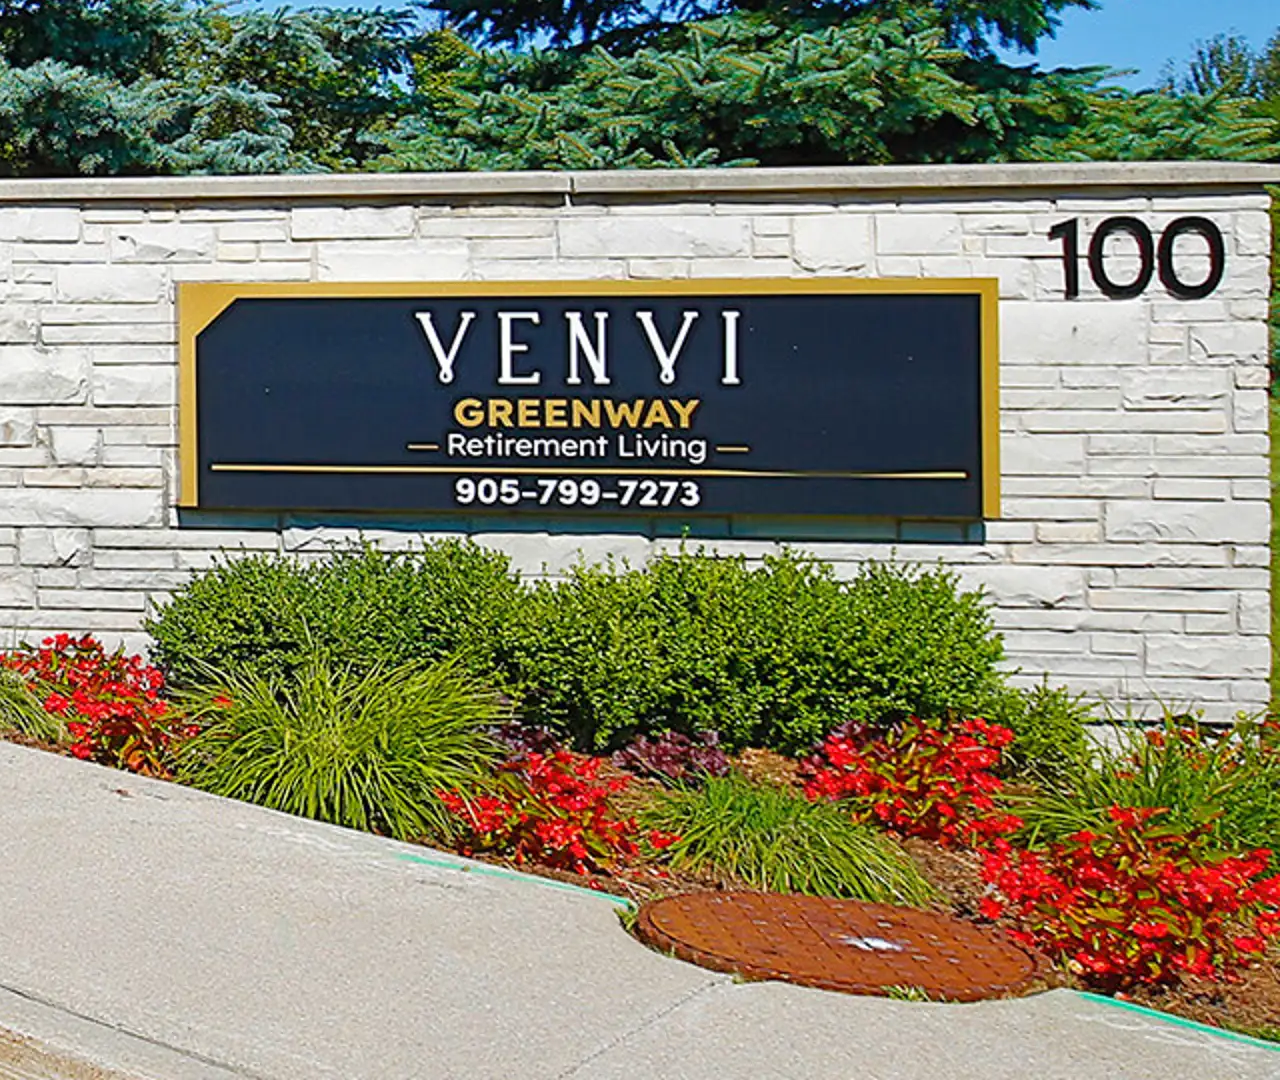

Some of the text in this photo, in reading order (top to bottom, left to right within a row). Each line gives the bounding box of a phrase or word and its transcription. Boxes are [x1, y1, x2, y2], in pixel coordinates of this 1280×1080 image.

[1048, 216, 1225, 300] 100
[414, 310, 741, 385] VENVI
[454, 398, 700, 429] GREENWAY
[448, 433, 707, 463] Retirement Living
[455, 479, 700, 507] 905-799-7273
